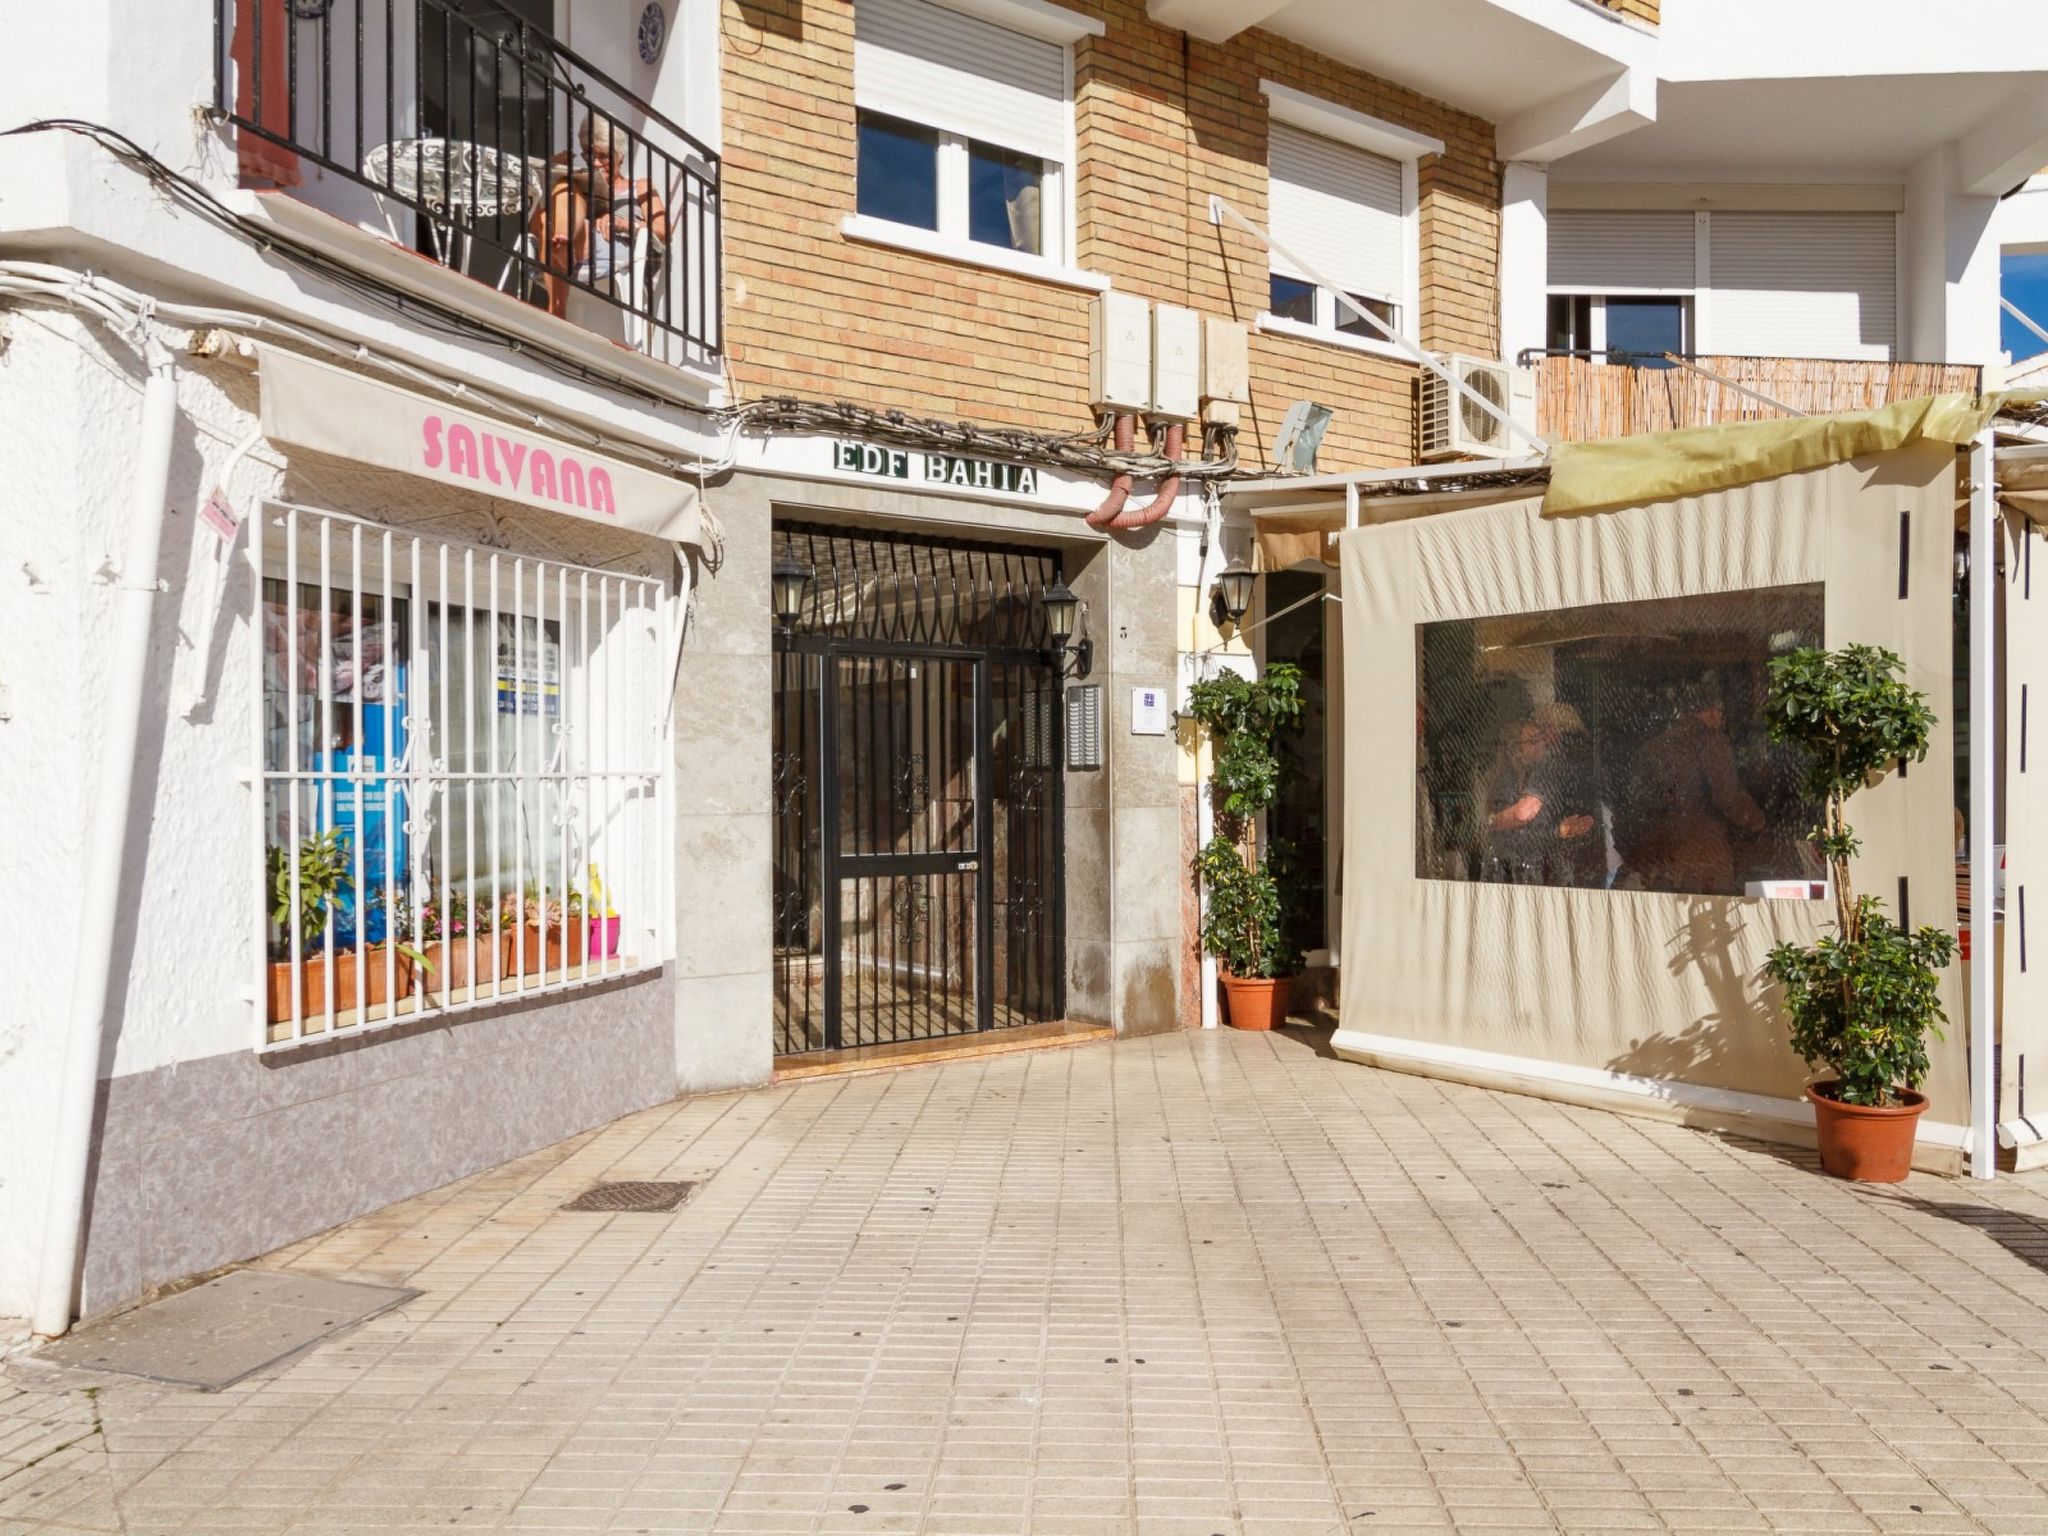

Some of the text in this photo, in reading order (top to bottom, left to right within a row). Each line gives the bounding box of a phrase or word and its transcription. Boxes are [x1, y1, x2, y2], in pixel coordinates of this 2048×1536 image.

[422, 415, 616, 515] SALVANA
[836, 441, 1037, 495] EDF BAHIA
